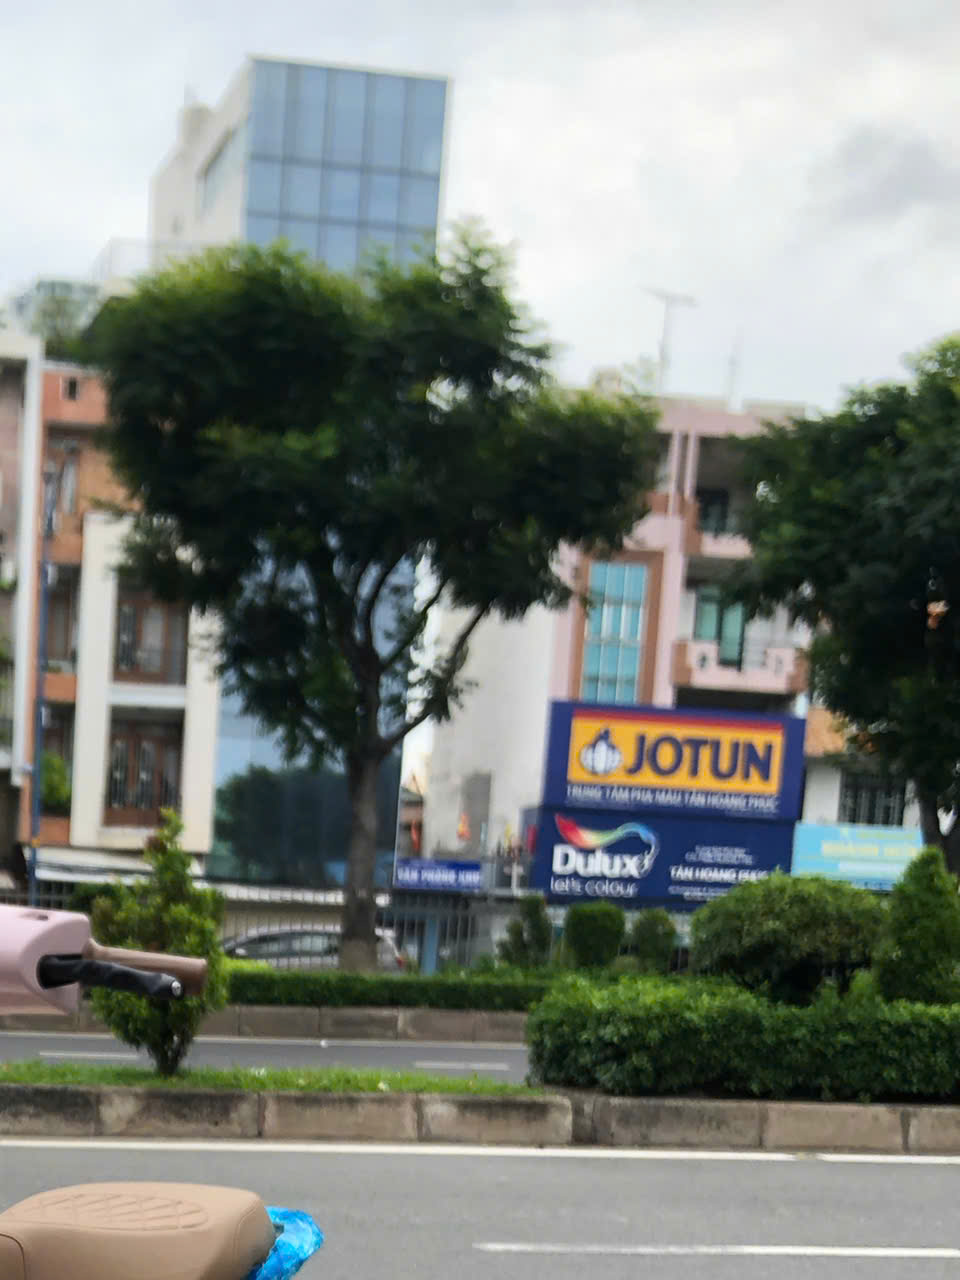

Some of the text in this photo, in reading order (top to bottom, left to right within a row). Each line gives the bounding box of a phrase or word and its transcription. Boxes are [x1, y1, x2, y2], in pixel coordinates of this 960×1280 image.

[624, 733, 773, 782] JOTUN
[552, 843, 642, 879] Dulux
[585, 880, 638, 898] colour
